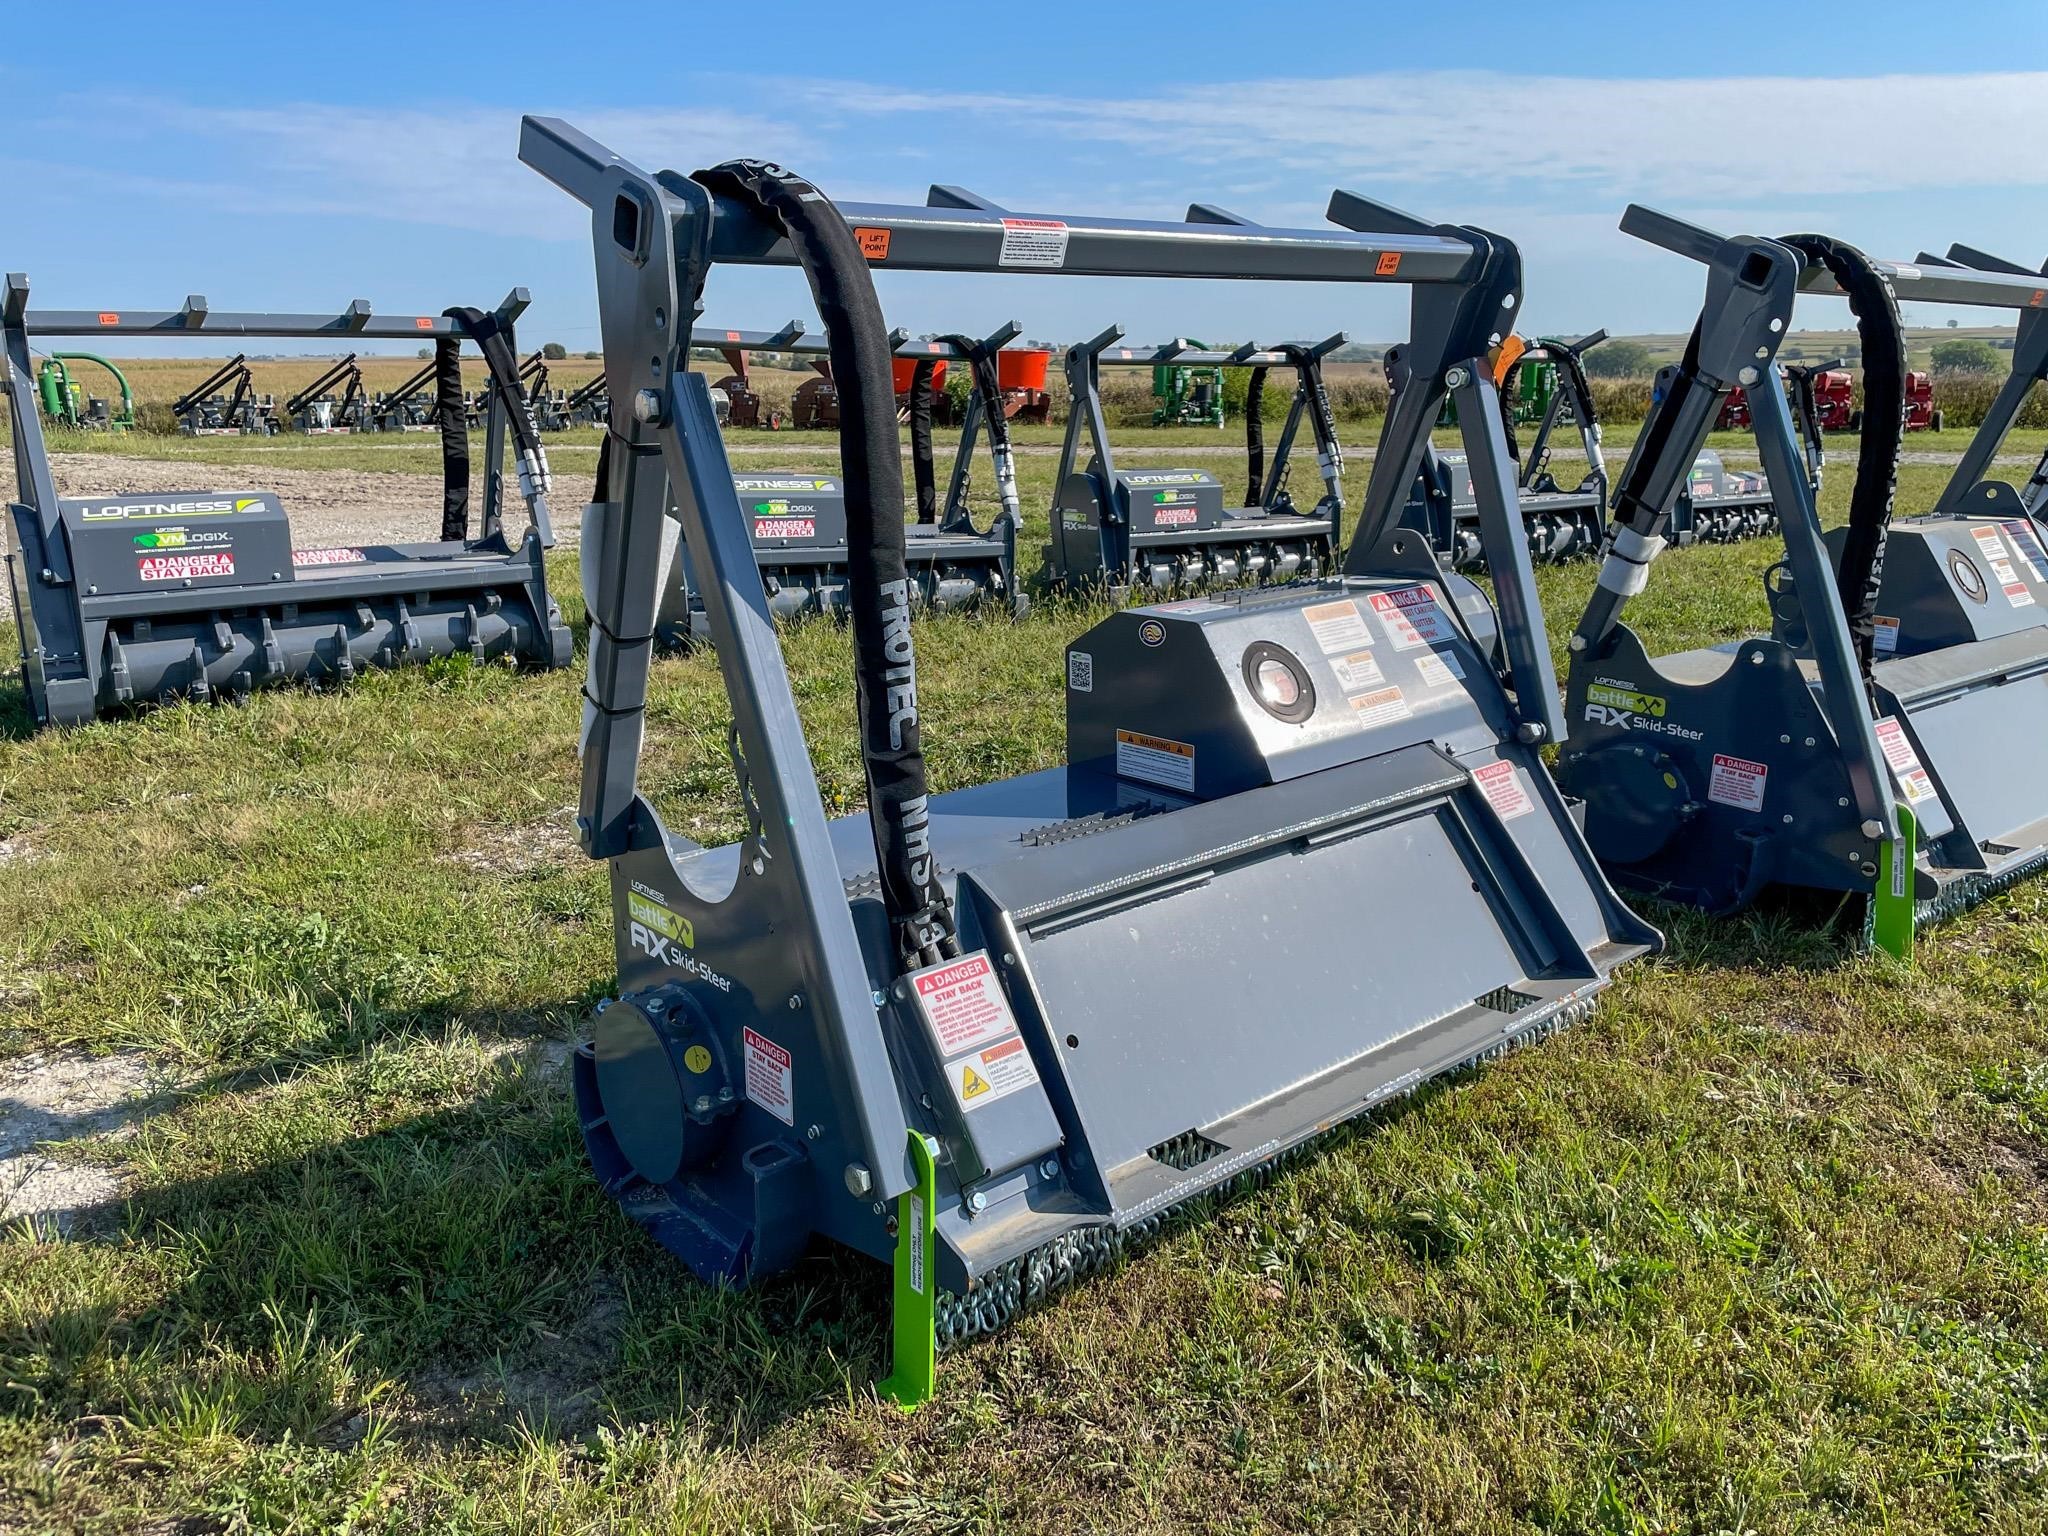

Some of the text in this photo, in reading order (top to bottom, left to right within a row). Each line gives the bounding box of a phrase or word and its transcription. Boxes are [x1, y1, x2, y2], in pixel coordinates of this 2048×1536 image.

[734, 480, 813, 490] OFTNESS
[1125, 474, 1193, 483] LOFTNESS
[82, 500, 232, 518] LOFTNESS
[1162, 509, 1191, 517] DANGER
[758, 528, 812, 537] STAY BACK
[765, 520, 805, 529] DANGER
[155, 554, 218, 569] DANGER
[144, 564, 231, 580] STAY BACK
[1387, 591, 1421, 608] DANGER
[879, 579, 919, 750] PROTEC
[1590, 687, 1634, 708] battle
[1584, 703, 1704, 740] AX Skid-Steer
[1140, 737, 1170, 751] WARNING
[1727, 759, 1762, 774] DANGER
[631, 879, 665, 903] LOFTNESS
[629, 895, 669, 931] battle
[630, 920, 731, 993] AX Skid-Steer
[934, 962, 984, 986] DANGER
[934, 980, 985, 1003] STAY BACK
[755, 1037, 787, 1064] DANGER
[752, 1049, 783, 1075] STAY BACK
